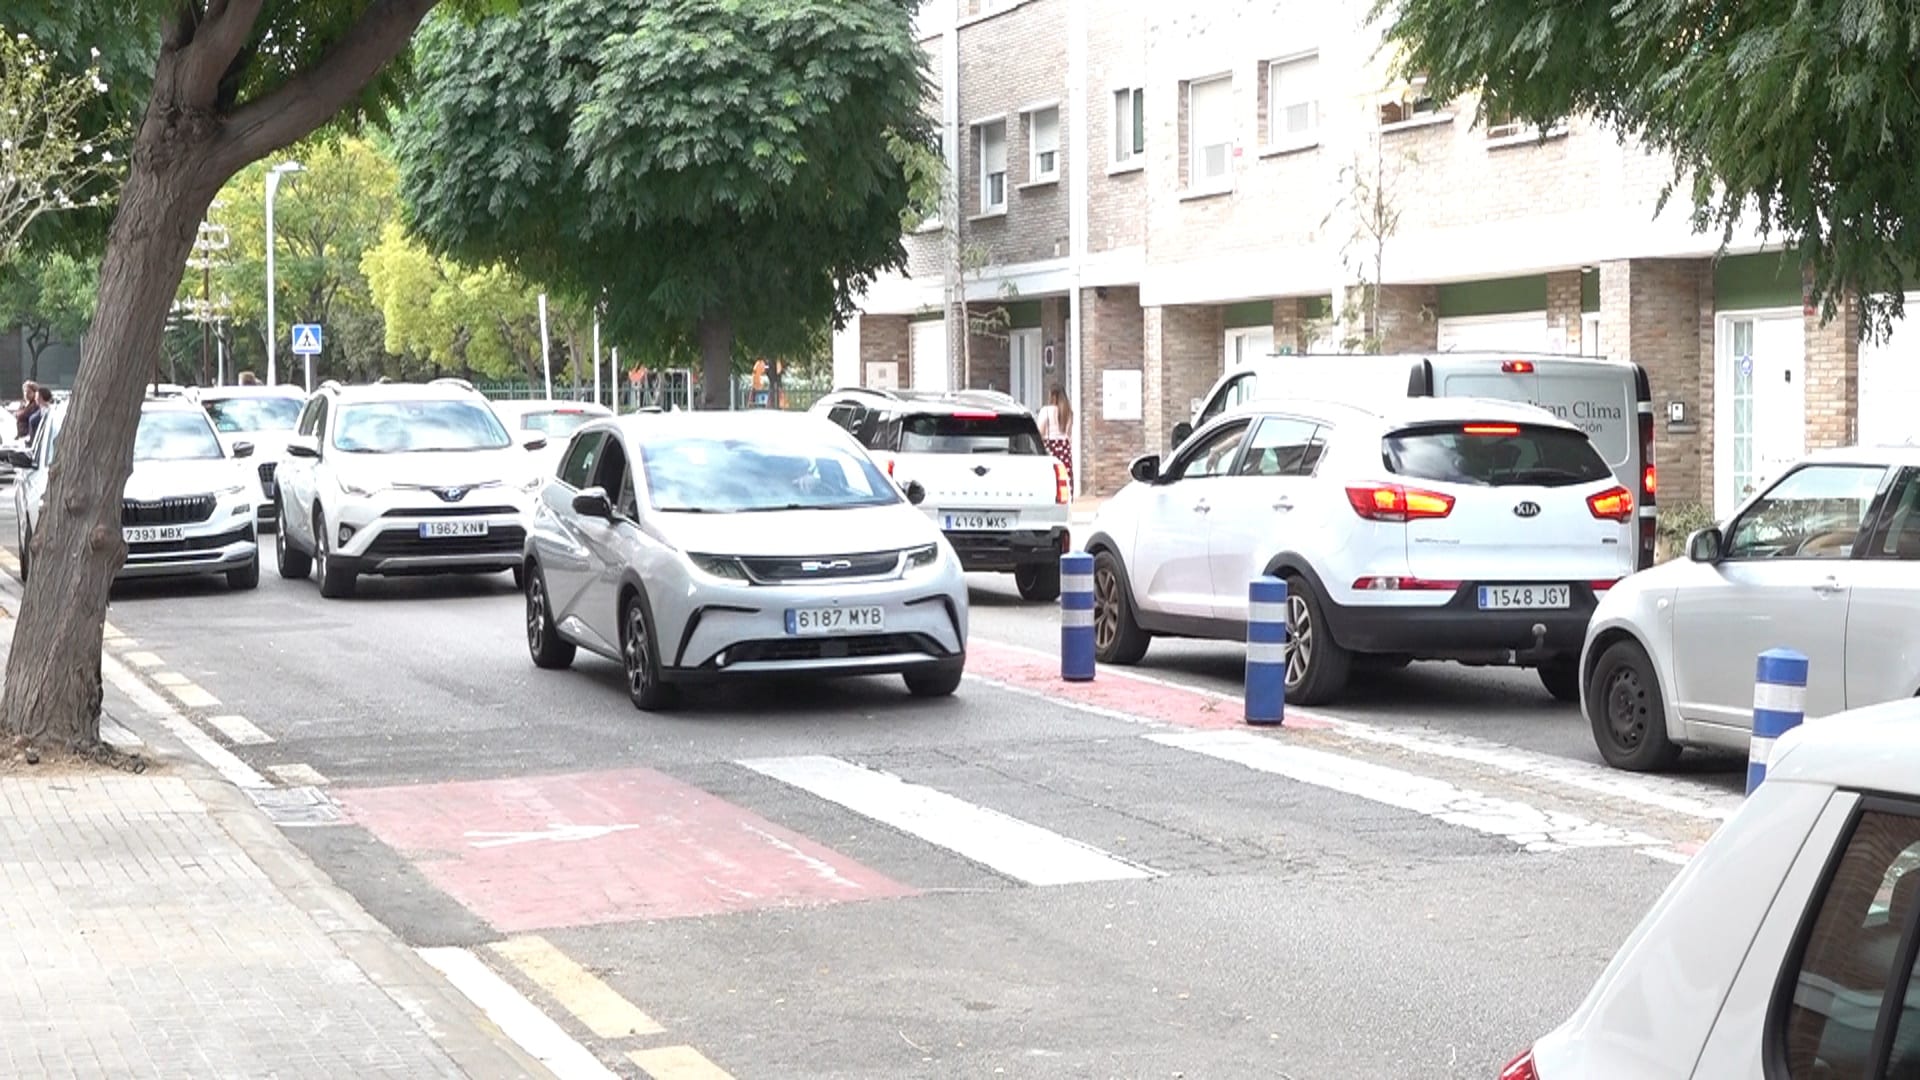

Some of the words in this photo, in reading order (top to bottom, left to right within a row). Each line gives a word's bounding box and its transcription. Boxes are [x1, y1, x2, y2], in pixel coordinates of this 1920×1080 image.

[1572, 400, 1621, 420] Clima
[430, 522, 459, 534] 1962
[955, 516, 983, 528] 4149
[126, 529, 156, 541] 7393
[160, 527, 182, 538] MBX
[1493, 585, 1534, 606] 1548
[1538, 587, 1567, 605] JGY
[799, 609, 842, 627] 6187
[849, 608, 881, 625] MYB
